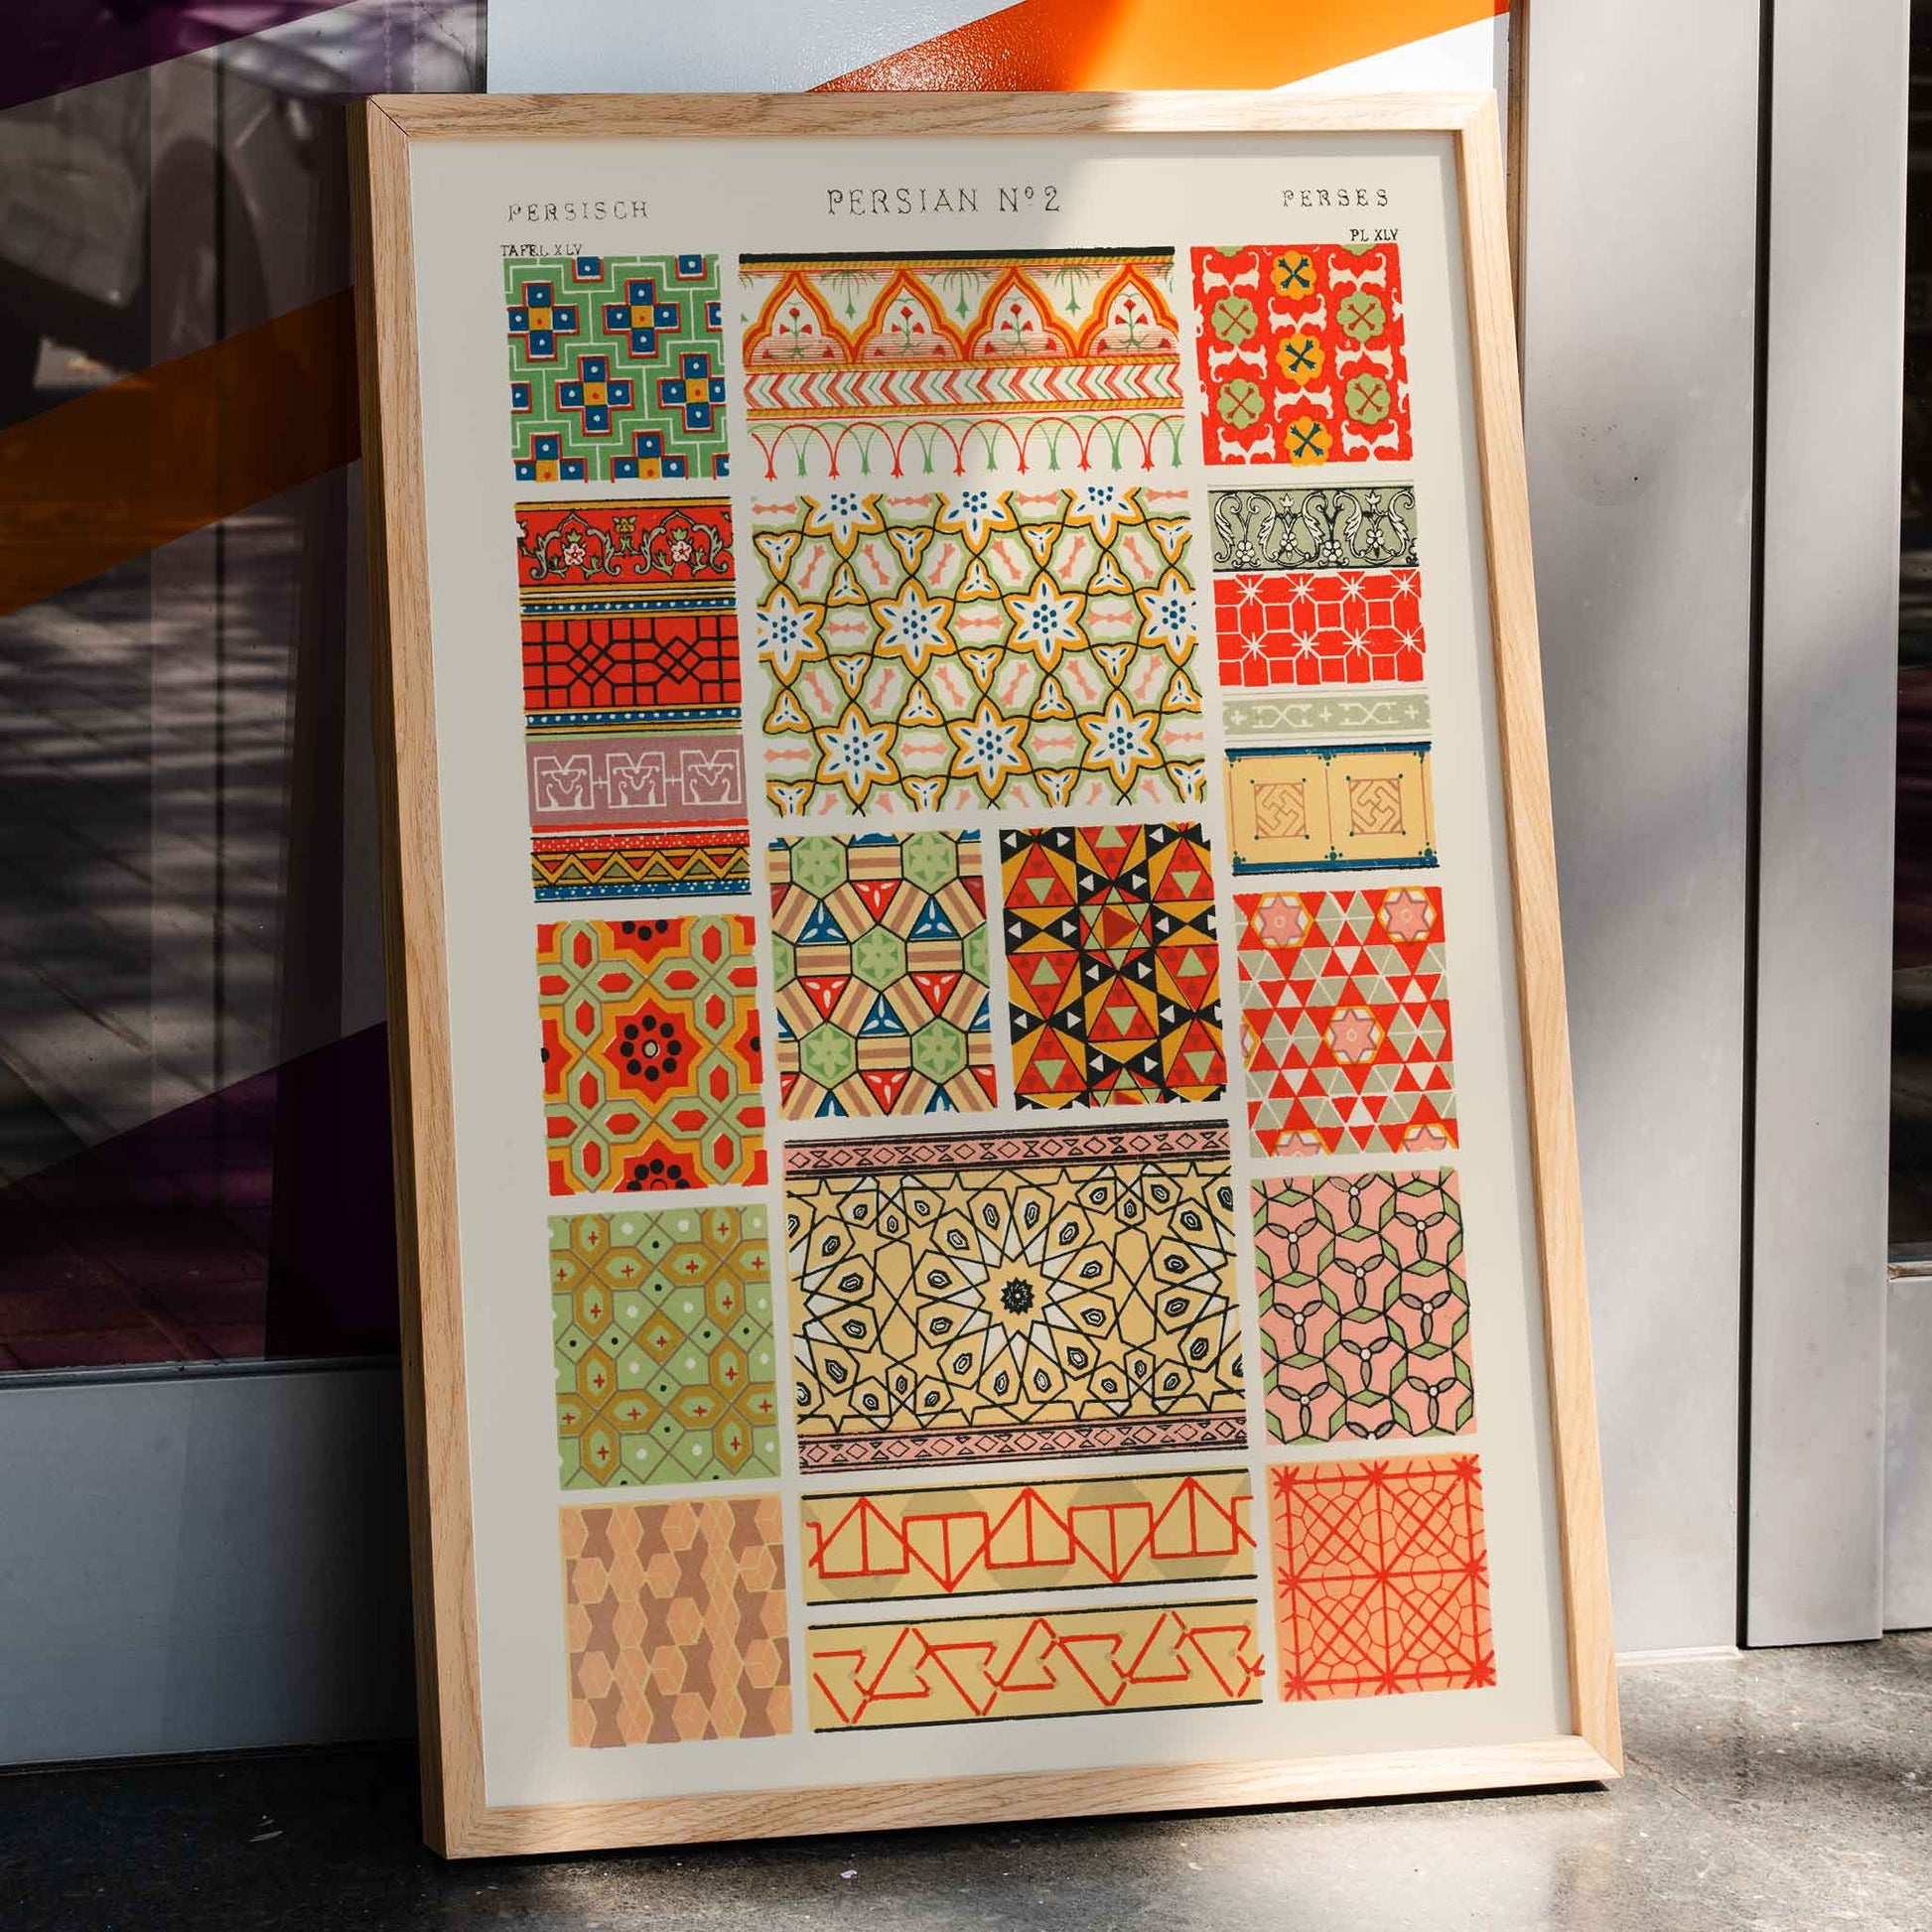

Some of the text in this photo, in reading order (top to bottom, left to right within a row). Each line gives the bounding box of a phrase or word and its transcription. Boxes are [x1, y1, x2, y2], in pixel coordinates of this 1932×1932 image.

[827, 188, 979, 215] PERSIAN
[1044, 186, 1060, 211] 2
[1282, 188, 1389, 207] PERSES
[507, 201, 649, 222] PERSISCH
[1349, 228, 1399, 242] PL XLV
[554, 243, 583, 256] XLV
